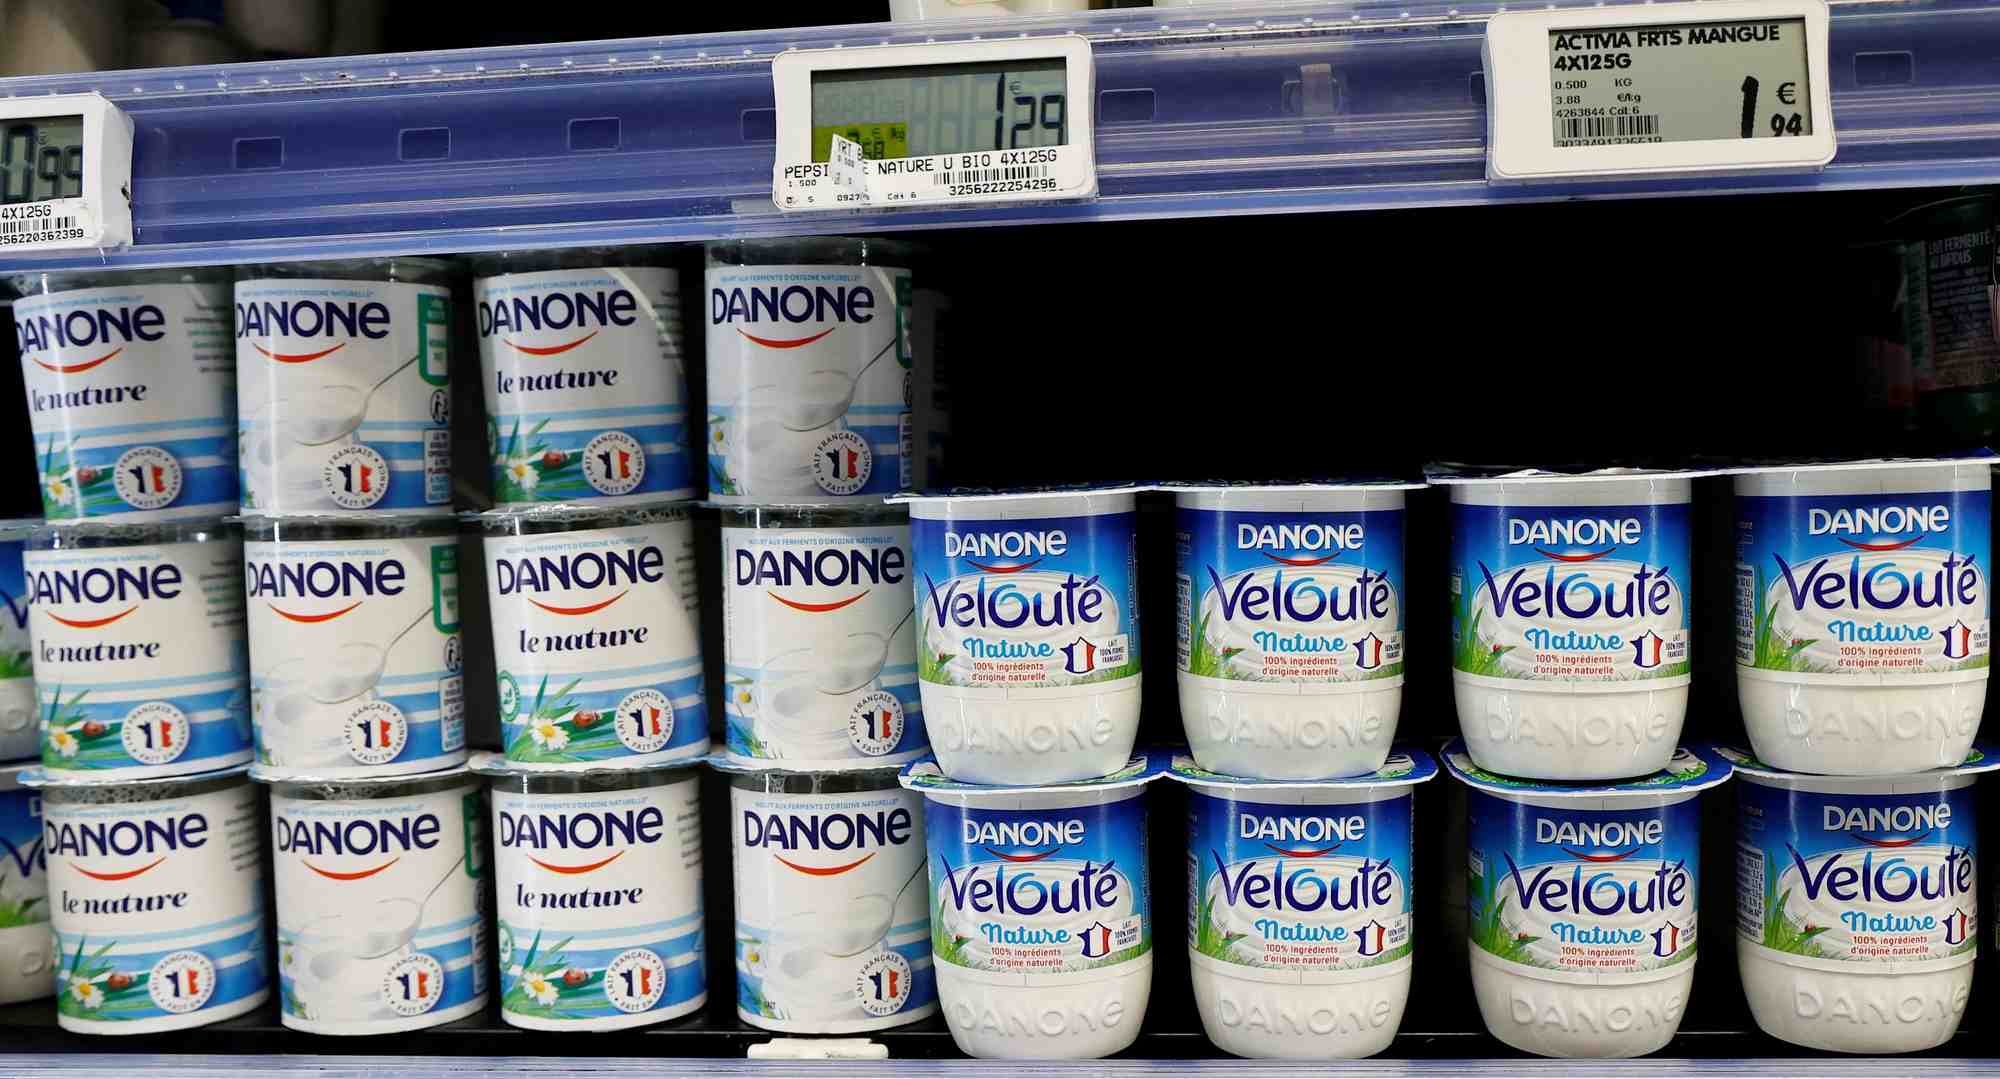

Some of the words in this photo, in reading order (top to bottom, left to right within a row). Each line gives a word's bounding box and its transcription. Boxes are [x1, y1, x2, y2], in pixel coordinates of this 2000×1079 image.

[1555, 32, 1631, 50] ACTIVIA
[1637, 30, 1682, 47] FRTS
[1688, 25, 1780, 45] MANGUE
[1554, 53, 1632, 71] 4X125G
[1554, 80, 1587, 90] 0.500
[1615, 78, 1632, 87] KG
[1556, 96, 1581, 105] 3.88
[1776, 82, 1796, 105] €
[1555, 108, 1605, 119] 4263844
[1741, 75, 1759, 138] 1
[1771, 112, 1802, 138] 94
[878, 159, 934, 175] NATURE
[943, 157, 952, 169] U
[962, 154, 991, 168] BIO
[1000, 149, 1057, 164] 4X125G
[949, 179, 1057, 196] 3256222254296
[1, 204, 52, 220] 4X125G
[497, 371, 513, 394] le
[519, 367, 618, 392] nature
[33, 388, 47, 412] le
[48, 383, 148, 409] nature
[520, 629, 539, 653] le
[546, 626, 648, 652] nature
[1524, 627, 1625, 651] Nature
[1828, 619, 1934, 643] Nature
[963, 637, 1055, 659] Nature
[1252, 630, 1347, 654] Nature
[40, 640, 55, 662] le
[59, 642, 160, 662] nature
[1840, 647, 1866, 656] 100%
[1868, 646, 1922, 658] ingrédients
[973, 662, 994, 671] 100%
[996, 662, 1045, 673] ingrédients
[1263, 655, 1287, 665] 100%
[1289, 655, 1337, 667] ingrédients
[1536, 654, 1559, 664] 100%
[1561, 654, 1613, 666] ingrédients
[1838, 657, 1880, 668] d'origine
[1882, 656, 1924, 667] naturelle
[971, 672, 1006, 682] d'origine
[1008, 672, 1046, 682] naturelle
[1262, 666, 1298, 677] d'origine
[1301, 666, 1339, 676] naturelle
[1533, 664, 1572, 676] d'origine
[1574, 664, 1614, 675] naturelle
[62, 890, 78, 912] le
[84, 890, 188, 914] nature
[517, 883, 535, 908] le
[540, 887, 643, 908] nature
[1255, 918, 1349, 942] Nature
[1841, 910, 1937, 934] Nature
[981, 922, 1071, 945] Nature
[1551, 922, 1646, 945] Nature
[1853, 936, 1877, 945] 100%
[1879, 935, 1928, 946] ingrédients
[991, 947, 1012, 957] 100%
[1013, 947, 1062, 958] ingrédients
[1265, 944, 1288, 954] 100%
[1290, 944, 1338, 955] ingrédients
[1561, 946, 1585, 956] 100%
[1587, 947, 1635, 959] ingrédients
[1851, 946, 1890, 957] d'origine
[1892, 945, 1929, 956] naturelle
[990, 957, 1024, 968] d'origine
[1026, 957, 1063, 967] naturelle
[1263, 954, 1300, 965] d'origine
[1302, 955, 1340, 964] naturelle
[1559, 957, 1597, 968] d'origine
[1599, 958, 1637, 967] naturelle
